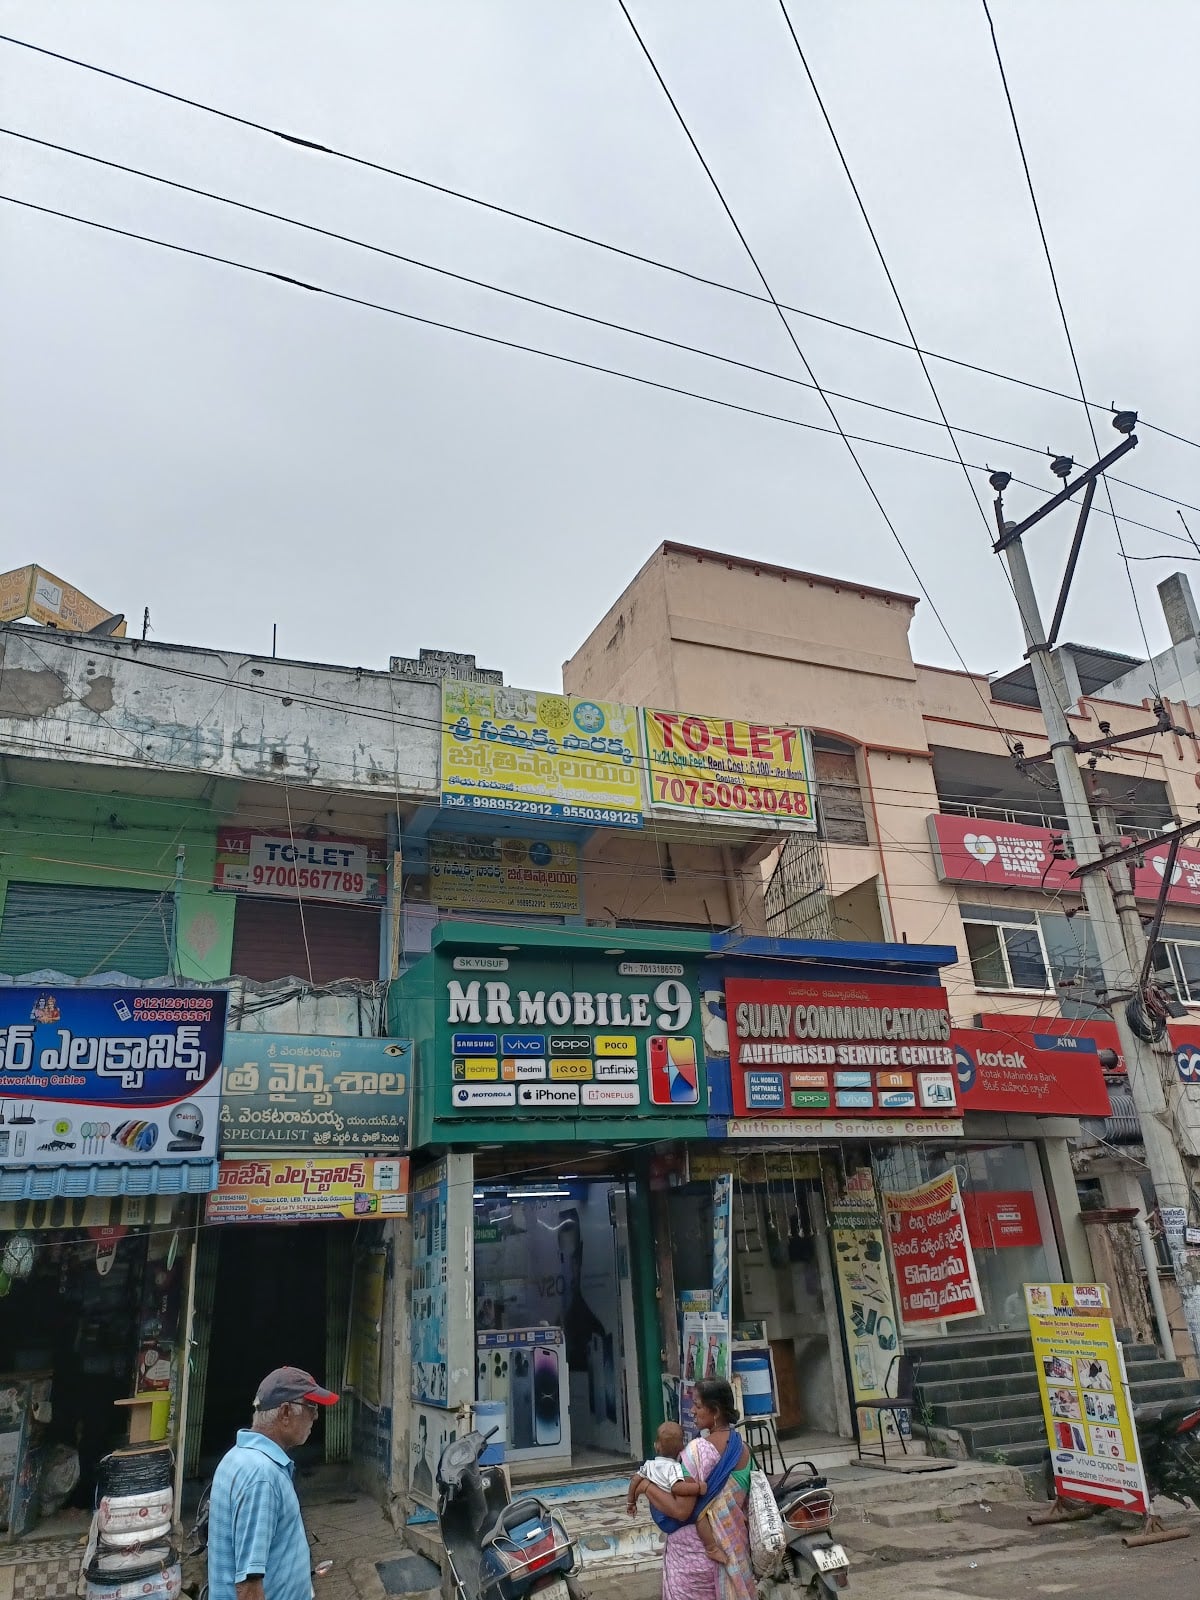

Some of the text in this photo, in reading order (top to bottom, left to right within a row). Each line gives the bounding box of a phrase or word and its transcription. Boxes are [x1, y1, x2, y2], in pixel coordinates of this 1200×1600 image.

[448, 716, 473, 743] శ్రీ
[653, 712, 797, 763] TO-LET
[707, 756, 725, 771] Rent
[727, 759, 744, 772] Cost
[655, 775, 808, 816] 7075003048
[473, 796, 553, 815] 9989522912
[562, 806, 639, 825] 9550349125
[995, 835, 1043, 849] RAINBOW
[264, 843, 355, 867] TO-LET
[997, 844, 1046, 862] BLOOD
[1001, 857, 1041, 874] BANK
[253, 864, 364, 893] 9700567789
[133, 997, 214, 1009] 8121261926
[447, 979, 693, 1032] MR MOBILE 9
[133, 1011, 212, 1022] 7095656561
[736, 1002, 951, 1042] SUJAY COMMUNICATIONS
[456, 1039, 628, 1050] SAMSUNG vivo oppo POCO
[1057, 1036, 1077, 1048] ATM
[738, 1043, 954, 1067] AUTHORISED SERVICE CENTER
[976, 1048, 1028, 1069] kotak
[466, 1065, 496, 1073] realme
[516, 1065, 542, 1074] Redmi
[599, 1064, 636, 1075] Infinix
[979, 1069, 1057, 1082] Kotak Mahindra Bank
[0, 1075, 86, 1087] etworking Cables
[268, 1062, 333, 1106] వైద్య
[333, 1071, 406, 1096] శాల
[750, 1076, 779, 1084] ALL MOBILE
[535, 1089, 577, 1101] iPhone
[600, 1091, 634, 1099] ONEPLUS
[751, 1085, 775, 1093] SOFTWARE
[751, 1093, 780, 1101] UNLOCKING
[223, 1128, 309, 1141] SPECIALIST
[731, 1122, 957, 1135] Authorised Service Center
[218, 1162, 271, 1189] రాజేష్
[1075, 1458, 1097, 1467] vivo
[1097, 1461, 1118, 1471] oppo
[1076, 1470, 1098, 1481] realme
[1122, 1479, 1138, 1489] POCO
